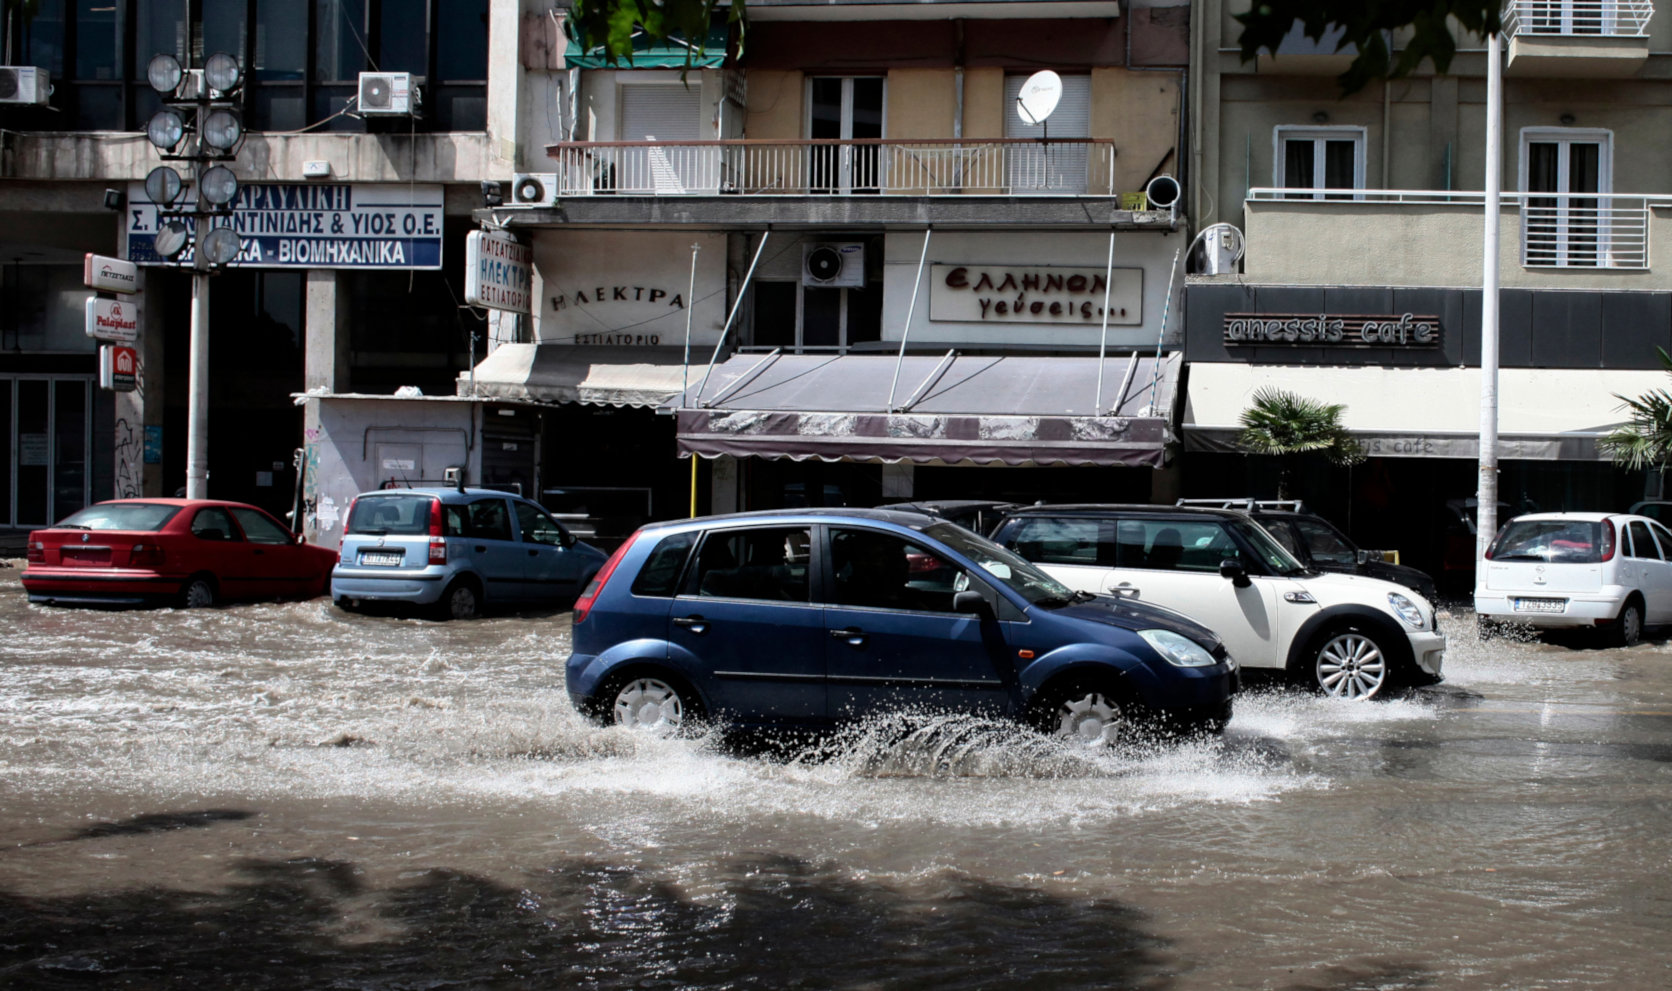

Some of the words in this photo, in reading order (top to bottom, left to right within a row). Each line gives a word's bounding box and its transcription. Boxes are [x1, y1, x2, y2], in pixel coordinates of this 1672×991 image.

[228, 186, 348, 210] ΔΡΑΥΛΙΚΗ
[131, 210, 148, 231] Σ.
[331, 213, 344, 234] &
[351, 213, 395, 234] ΥΙΟΣ
[403, 213, 440, 235] Ο.Ε.
[279, 239, 405, 264] ΒΙΟΜΗΧΑΝΙΚΑ
[551, 286, 684, 311] ΗΛΕΚΤΡΑ
[96, 315, 136, 330] Palaplast
[1229, 314, 1344, 342] anessis
[1361, 313, 1432, 344] cafe
[574, 334, 660, 345] ΕΣΤΙΑΤΟΡΙΟ
